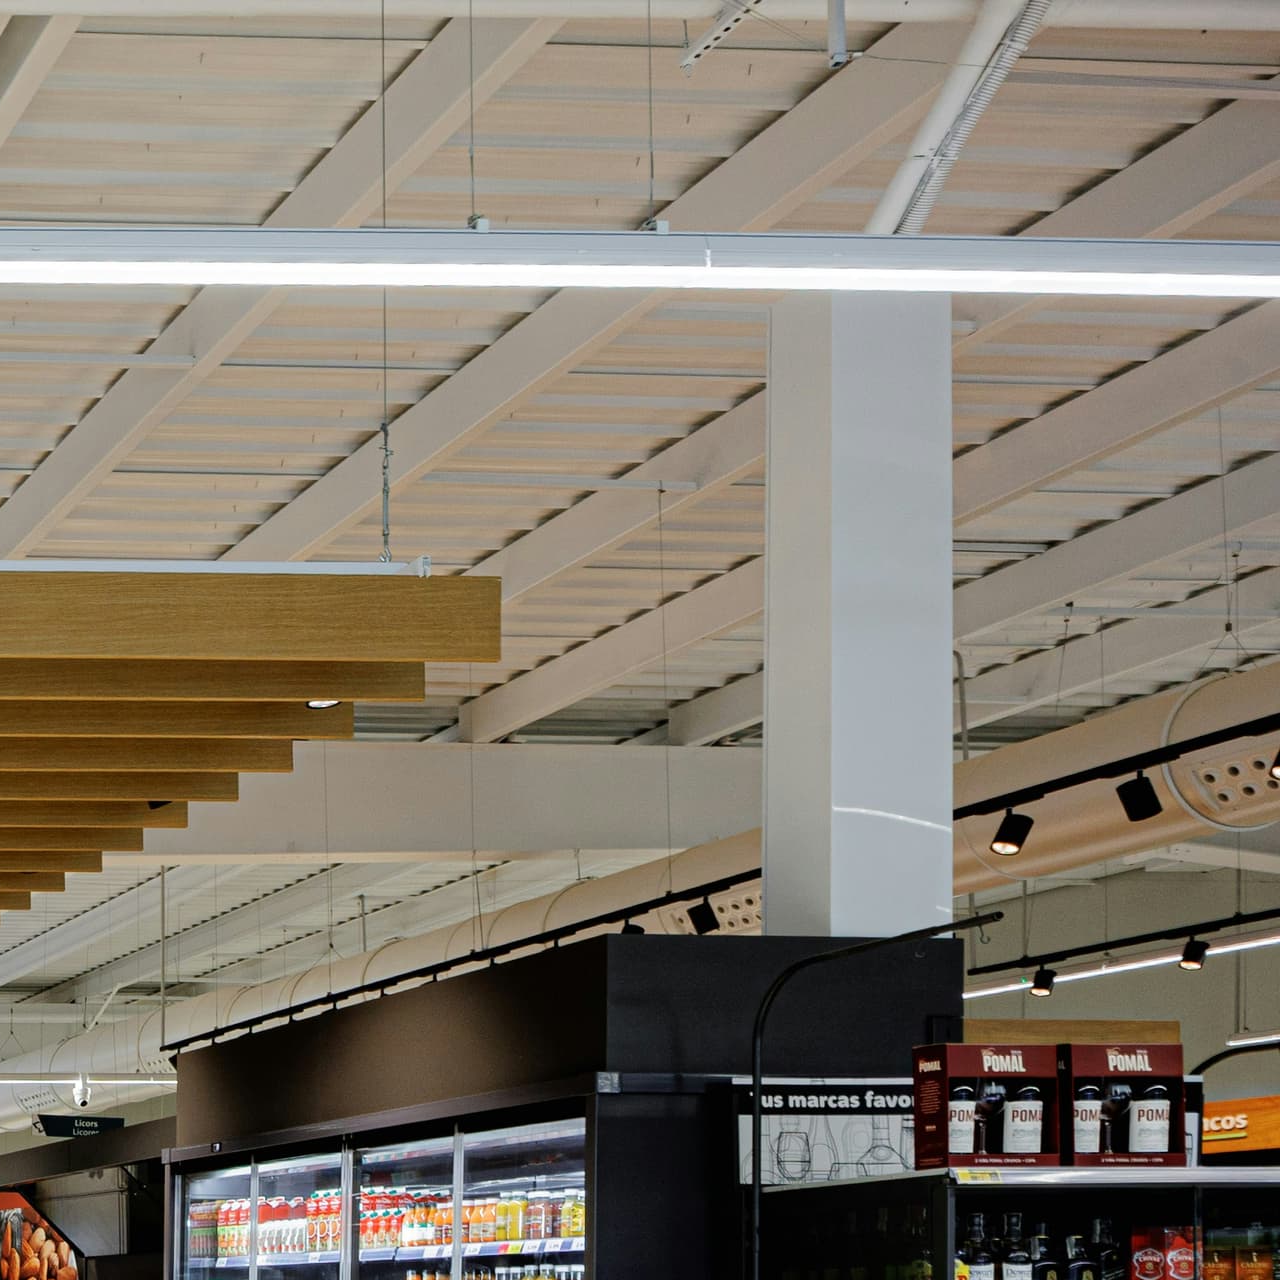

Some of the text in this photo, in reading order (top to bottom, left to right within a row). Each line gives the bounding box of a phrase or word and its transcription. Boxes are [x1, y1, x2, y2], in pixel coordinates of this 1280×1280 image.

[983, 1055, 1027, 1072] POMAL
[1108, 1055, 1153, 1072] POMAL
[788, 1095, 860, 1108] marcas
[75, 1119, 98, 1127] Licors
